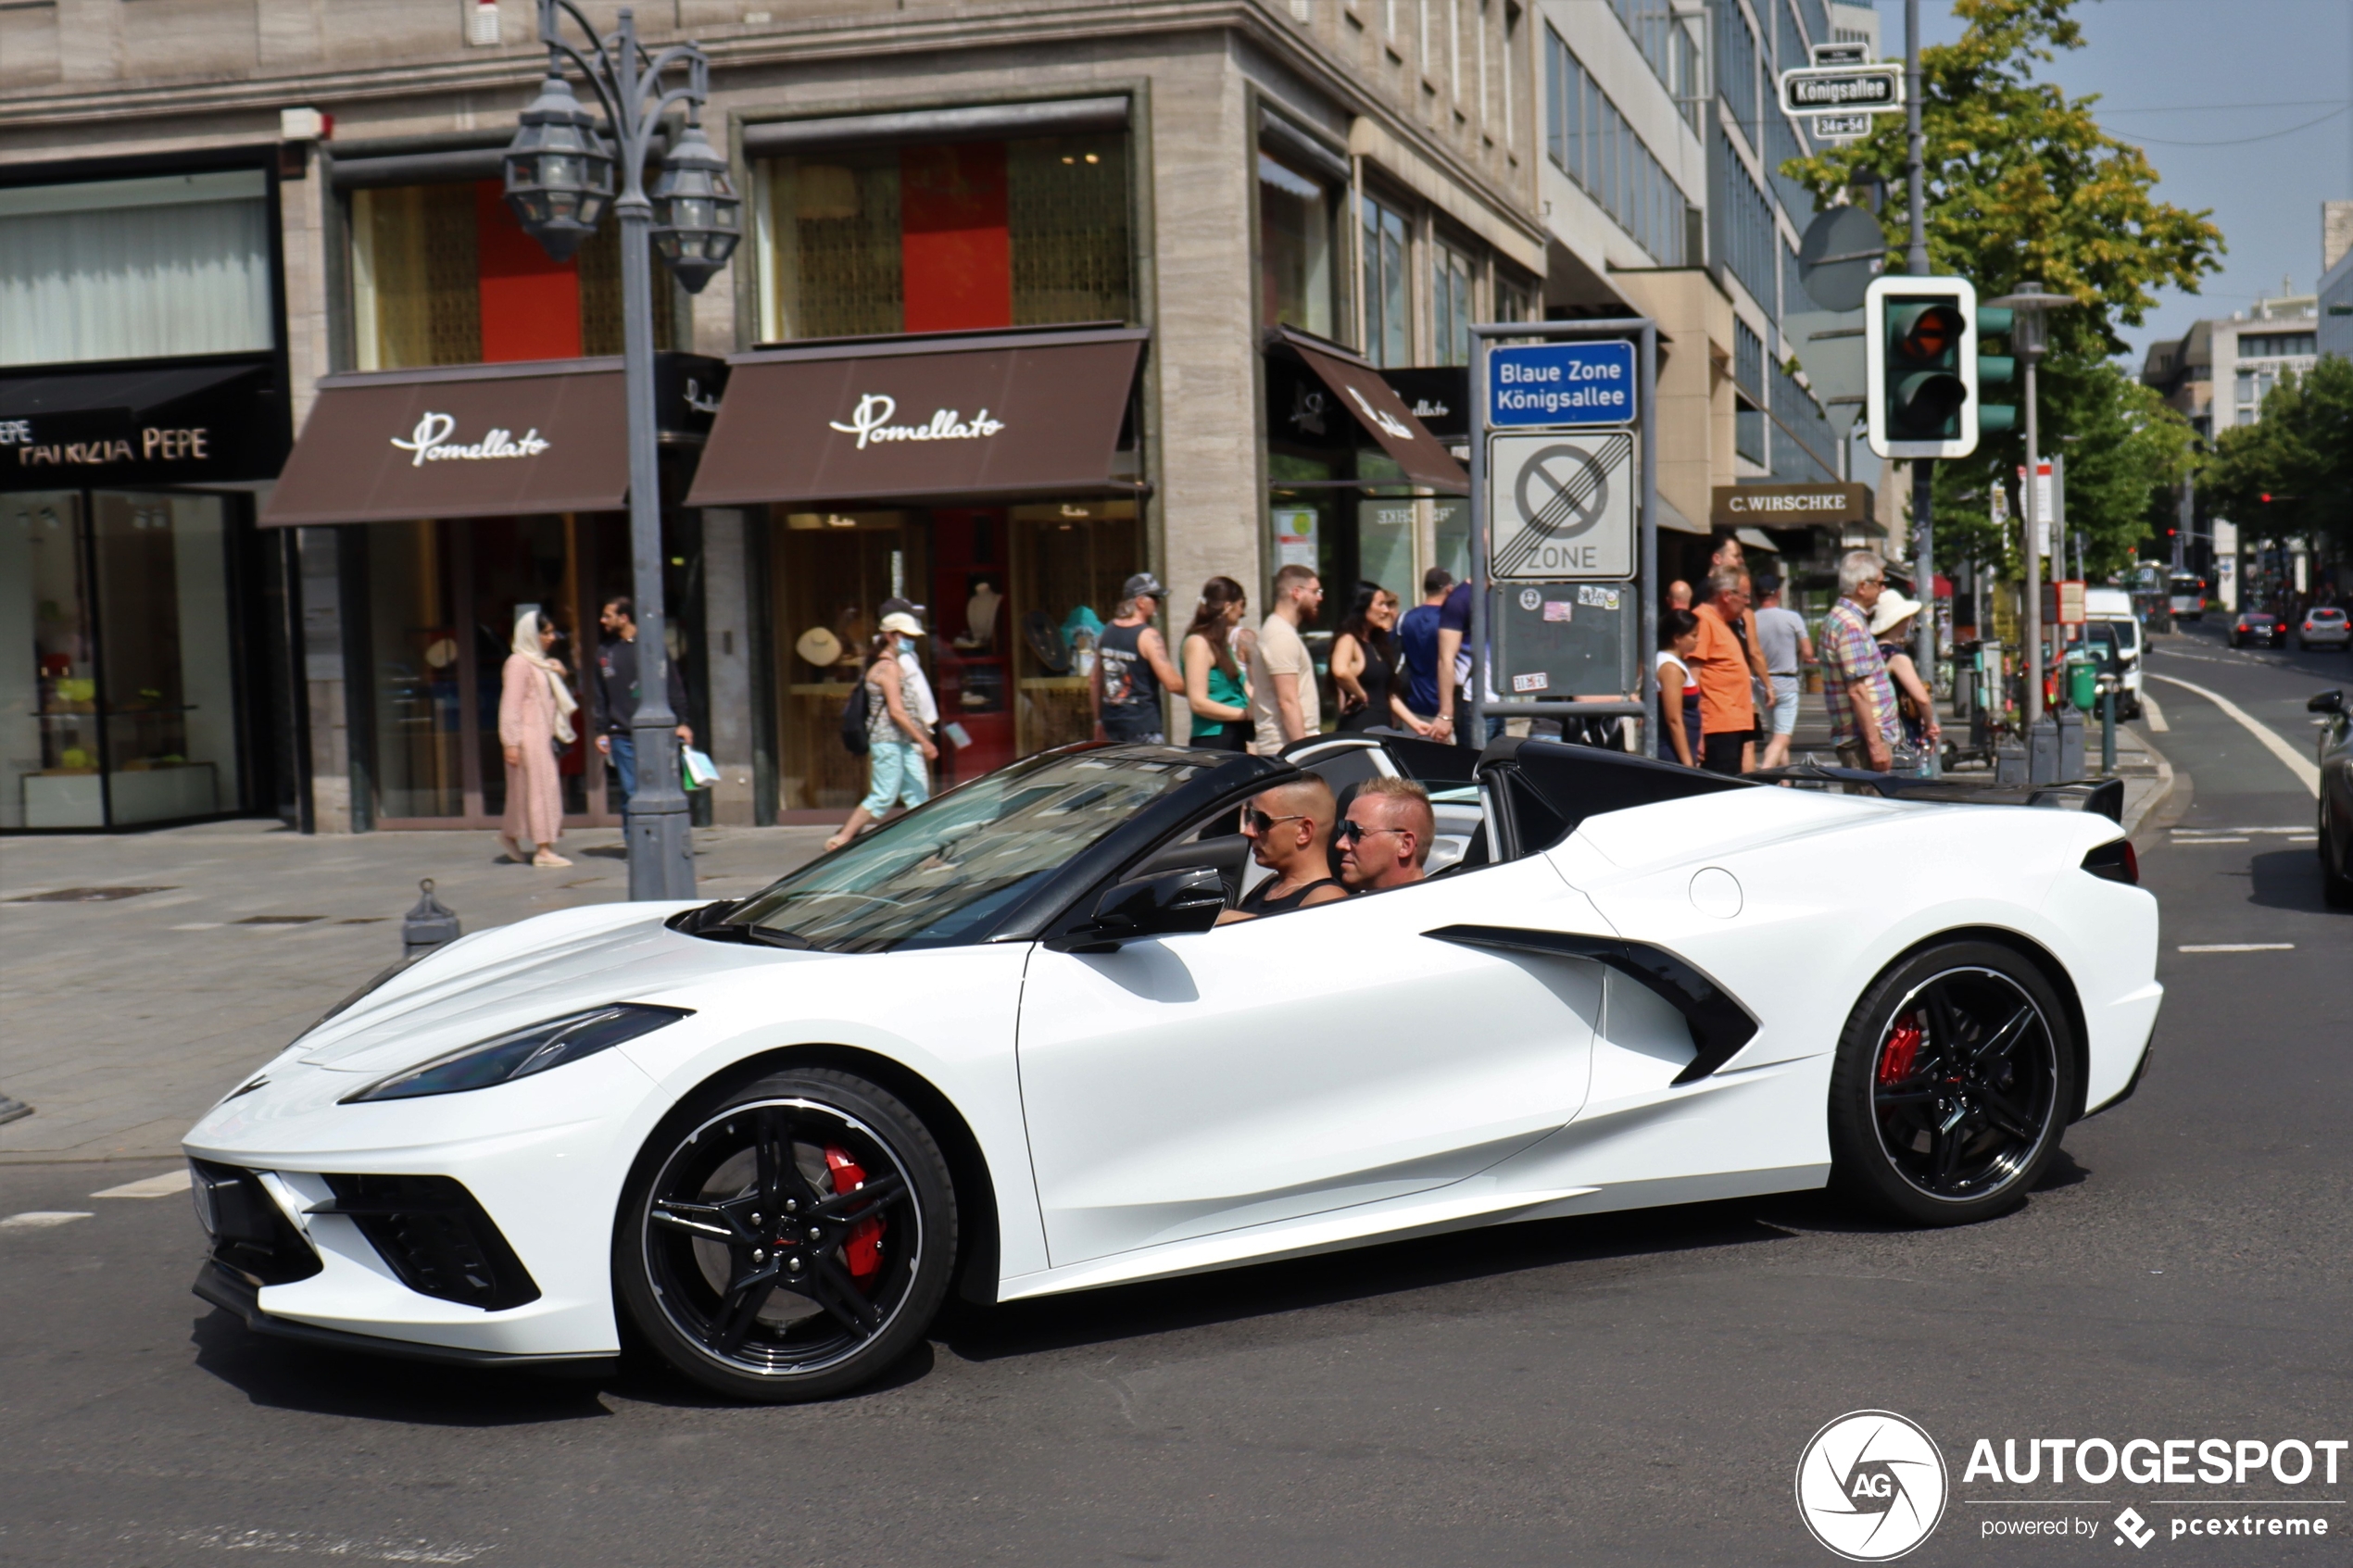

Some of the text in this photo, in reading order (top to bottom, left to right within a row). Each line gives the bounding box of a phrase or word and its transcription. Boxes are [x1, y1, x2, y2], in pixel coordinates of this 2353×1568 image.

[1795, 78, 1885, 103] Königsallee
[1820, 118, 1864, 132] 34a-54
[1500, 359, 1621, 383] Blaue Zone
[1497, 386, 1625, 413] Königsallee
[829, 394, 1005, 450] Pomellato
[142, 427, 208, 459] PEPE
[390, 411, 550, 467] Pomellato
[1527, 546, 1597, 569] ZONE
